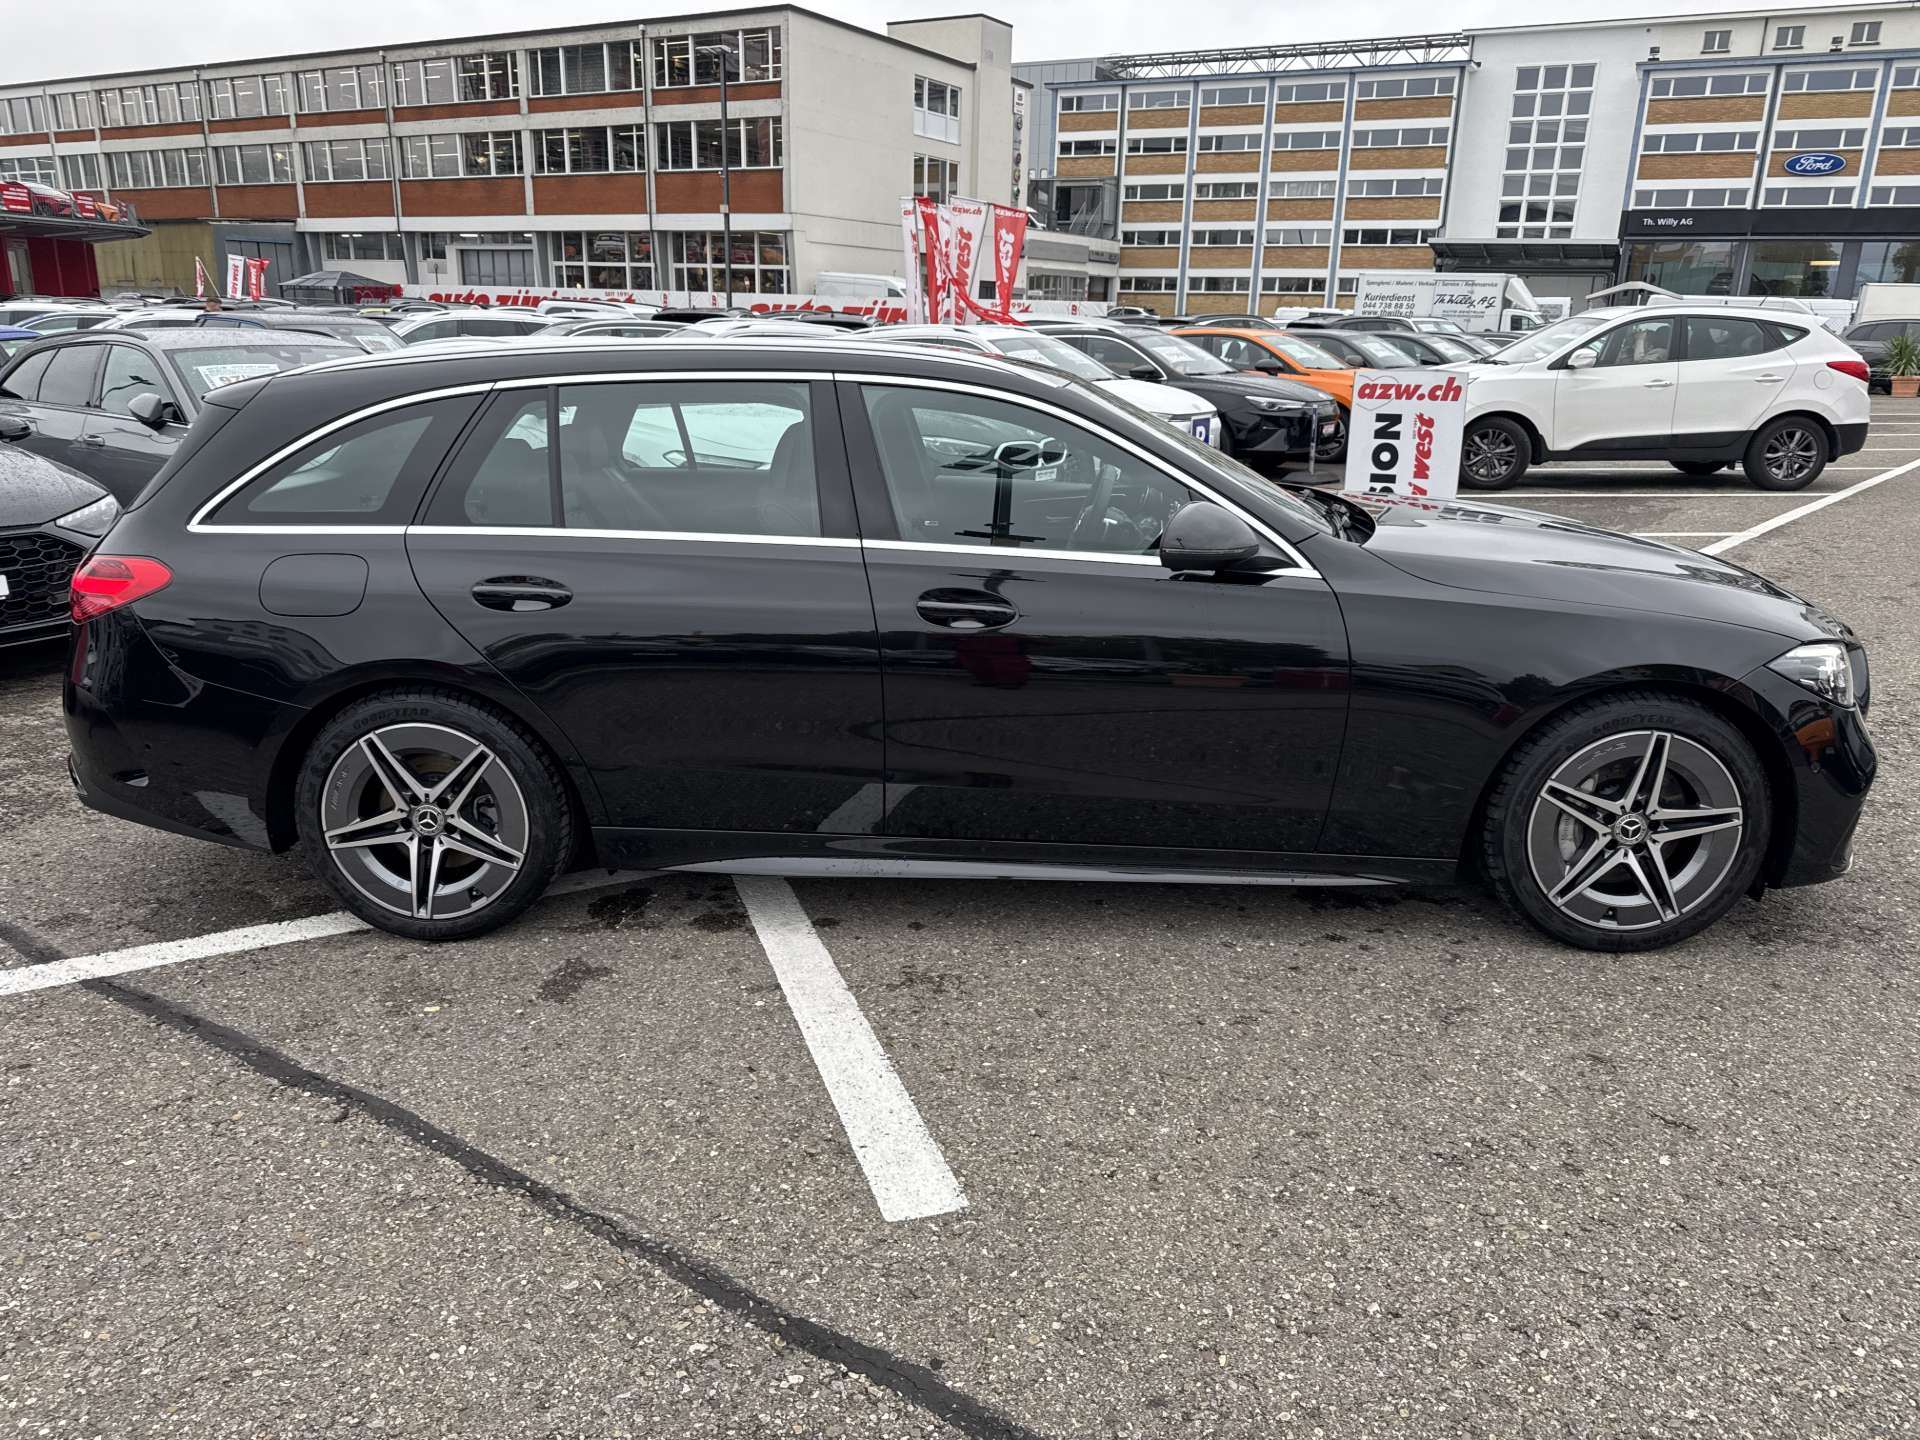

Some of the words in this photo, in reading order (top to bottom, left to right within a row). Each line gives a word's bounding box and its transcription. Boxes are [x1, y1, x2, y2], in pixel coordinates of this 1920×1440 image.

[1795, 156, 1834, 170] Ford
[1643, 217, 1656, 226] Th.
[1657, 217, 1679, 228] Willy
[1680, 217, 1693, 226] AG
[1364, 292, 1416, 302] Kurierdienst
[1362, 301, 1377, 309] 044
[1393, 302, 1404, 310] 88
[1405, 302, 1416, 310] 50
[1357, 376, 1463, 402] azw.ch
[1412, 411, 1435, 480] west
